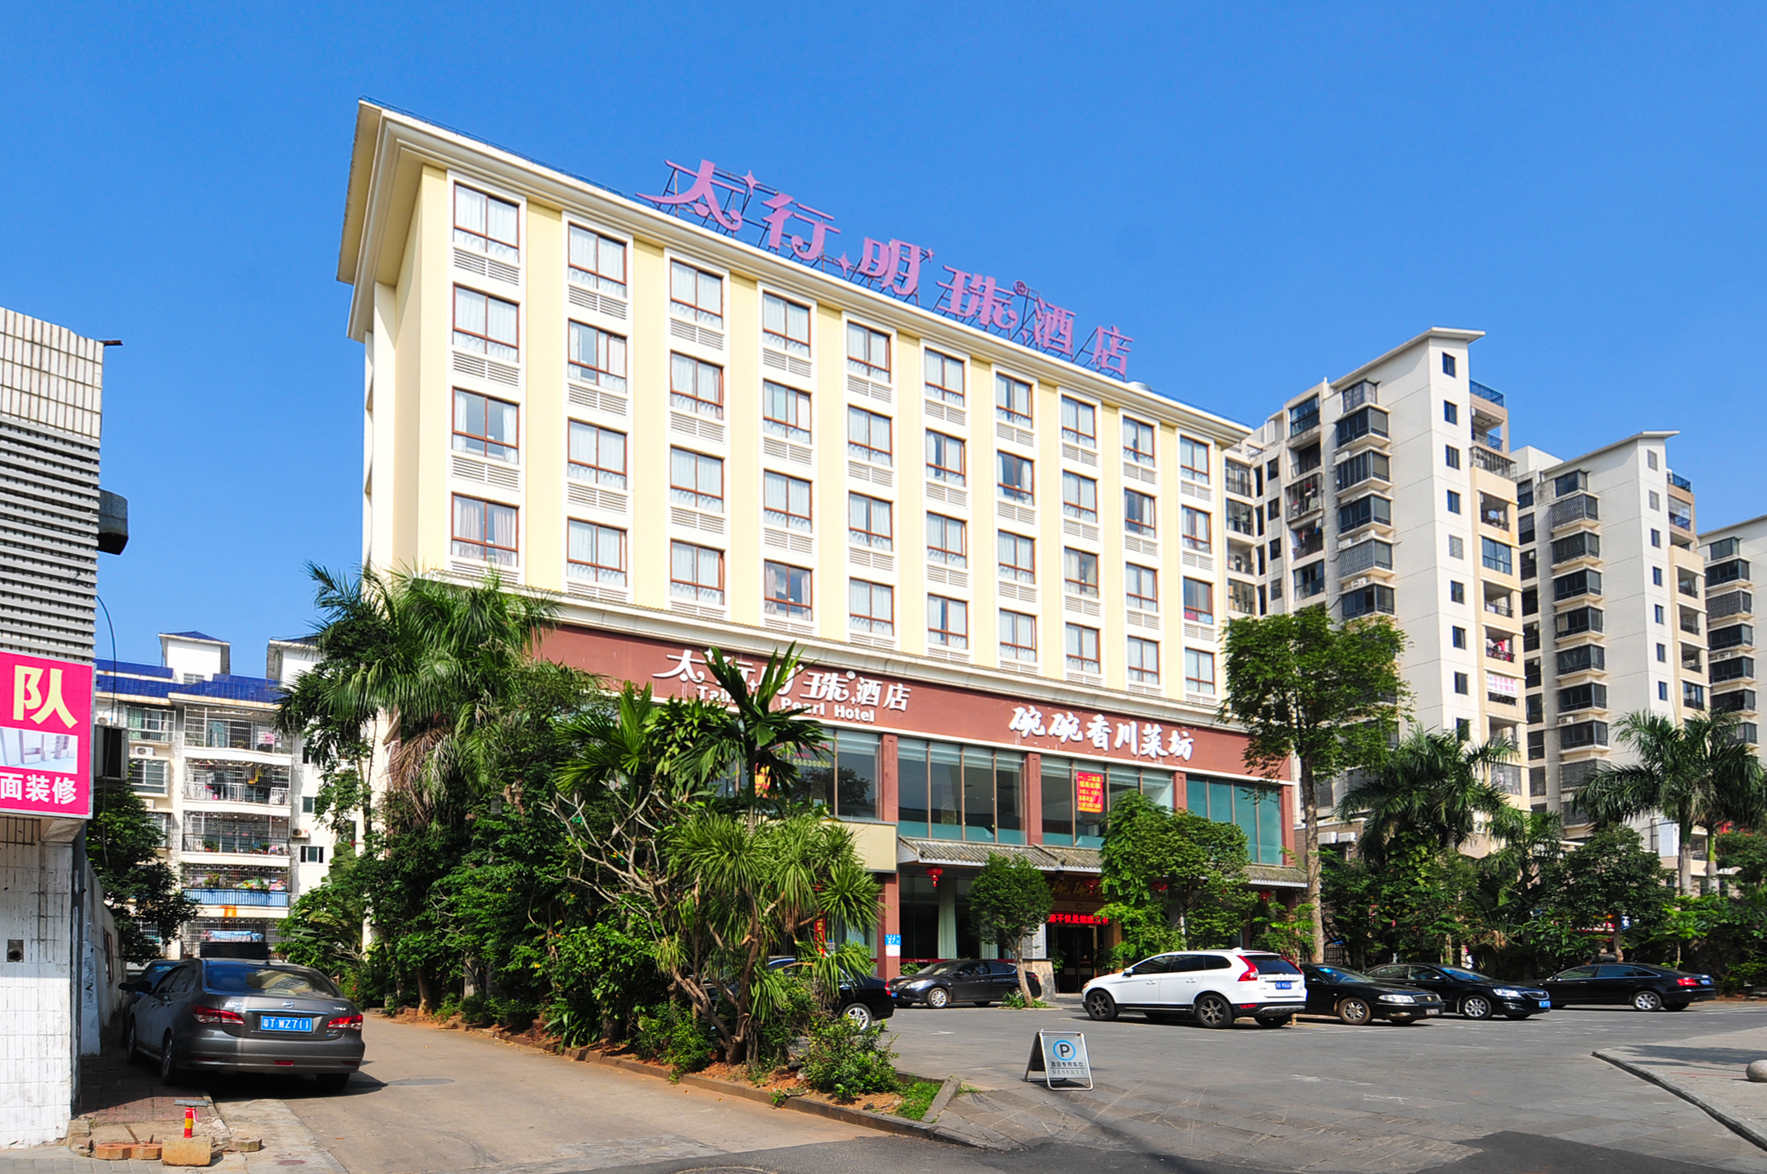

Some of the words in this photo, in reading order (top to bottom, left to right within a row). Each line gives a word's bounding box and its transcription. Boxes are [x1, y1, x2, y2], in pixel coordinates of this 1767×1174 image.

[13, 664, 78, 729] 队
[780, 696, 826, 716] Pearl
[834, 704, 876, 723] Hotel
[1008, 704, 1196, 762] 碗碗香川菜坊
[0, 772, 78, 805] 面装修
[1059, 1044, 1070, 1057] P
